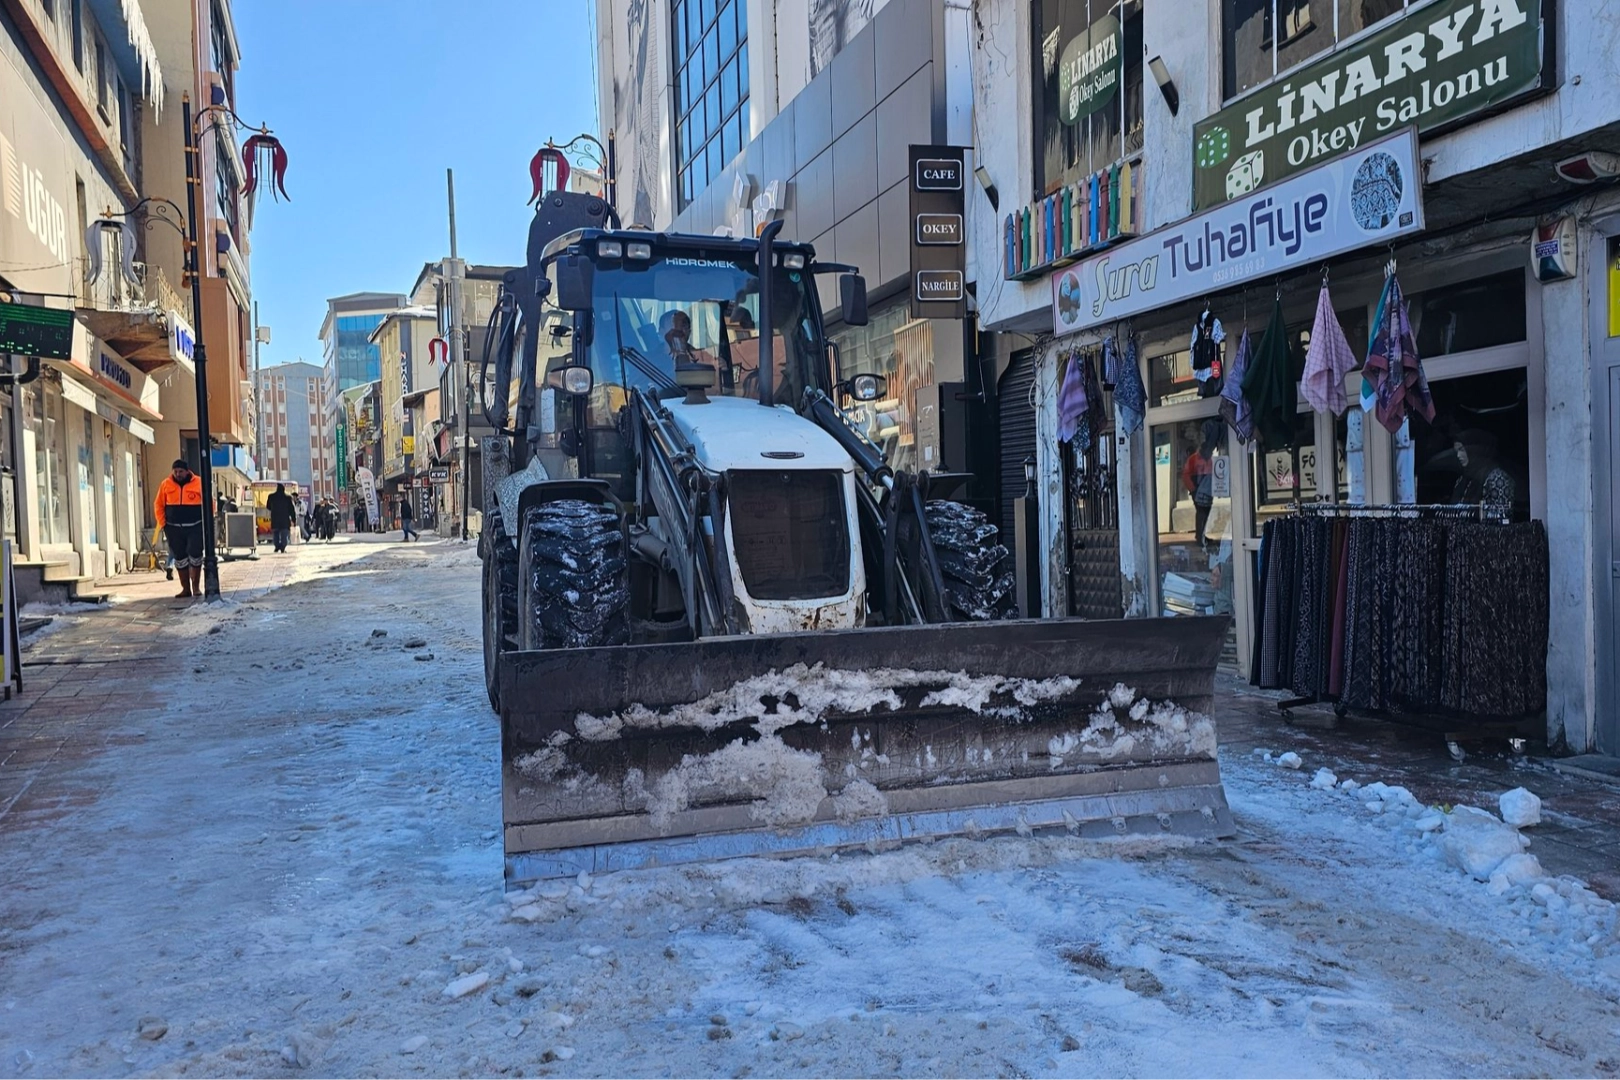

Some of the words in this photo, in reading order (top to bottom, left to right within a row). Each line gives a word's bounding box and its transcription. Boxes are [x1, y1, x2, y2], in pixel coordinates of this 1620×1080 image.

[1070, 32, 1118, 85] LİNARYA
[1245, 0, 1527, 148] LİNARYA
[1080, 82, 1094, 103] Okey
[1094, 68, 1116, 95] Salonu
[1286, 116, 1366, 166] Okey
[1376, 55, 1509, 132] Salonu
[923, 169, 956, 180] CAFE
[22, 161, 68, 268] UĞUR
[922, 224, 957, 234] OKEY
[1163, 192, 1328, 279] Tuhafiye
[921, 279, 960, 292] NARGİLE
